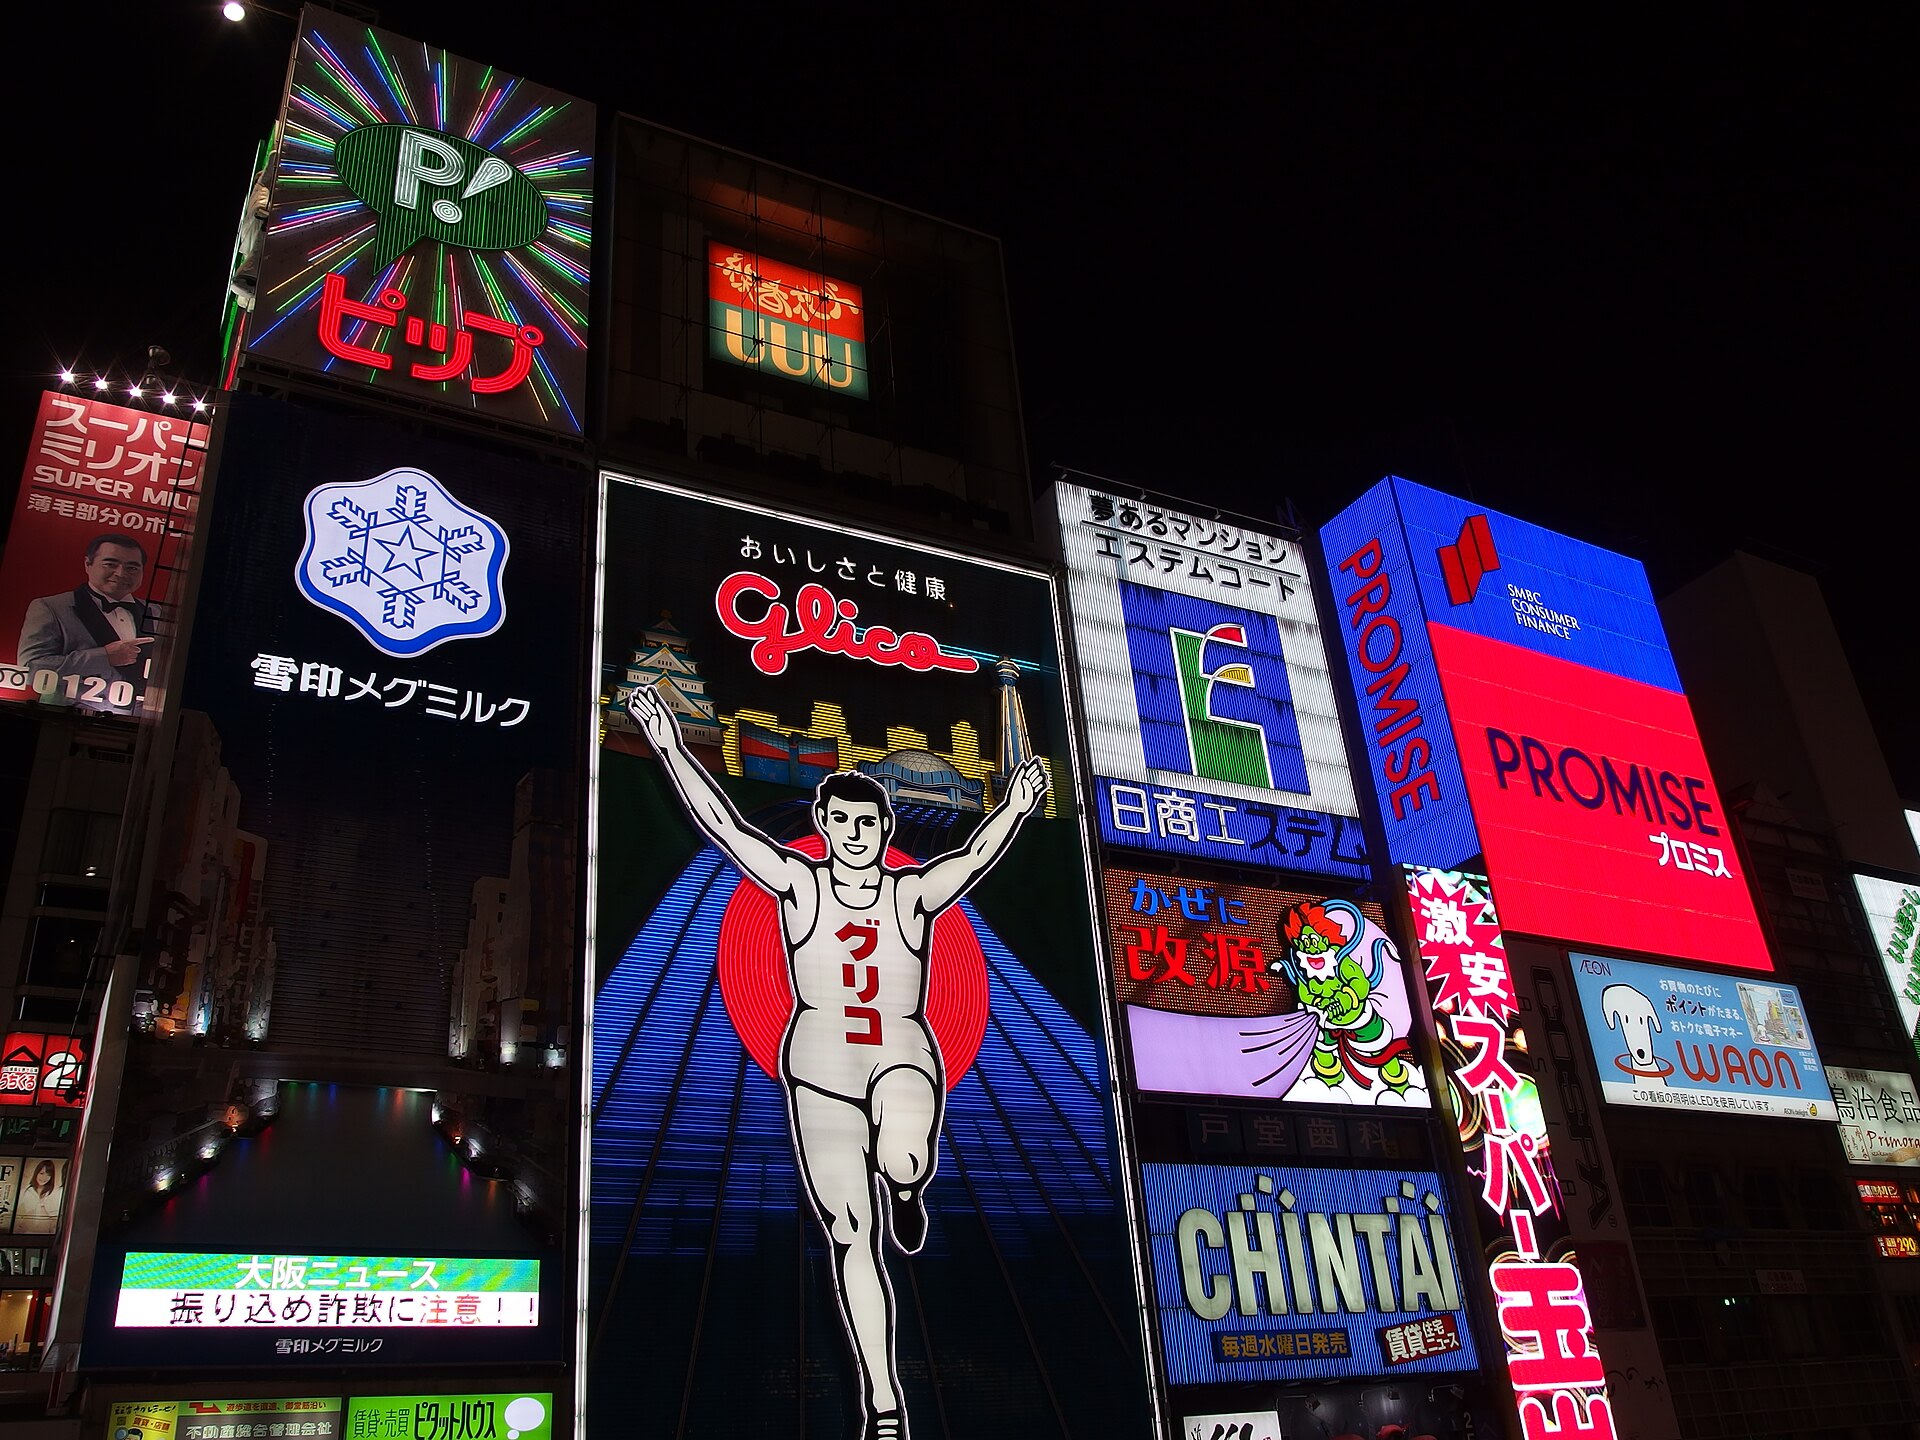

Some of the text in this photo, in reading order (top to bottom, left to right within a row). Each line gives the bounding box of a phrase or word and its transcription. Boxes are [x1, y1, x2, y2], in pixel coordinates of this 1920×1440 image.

[318, 272, 545, 393] ピップ
[726, 308, 853, 388] UUU
[45, 399, 206, 450] スーパー
[33, 464, 135, 499] SUPER
[1088, 495, 1287, 564] 夢あるマンション
[740, 535, 946, 601] おいしさと健康
[1095, 533, 1296, 602] エステムコート
[1507, 583, 1543, 605] SMBC
[1511, 598, 1581, 630] CONSUMER
[715, 570, 980, 676] Glico
[1515, 611, 1572, 640] FINANCE
[250, 652, 531, 727] 雪印メグミルク
[1340, 538, 1442, 821] PROMISE
[1485, 726, 1720, 837] PROMISE
[1110, 784, 1372, 864] 日商エステム
[1648, 831, 1733, 879] プロミス
[1129, 878, 1249, 926] かぜに
[834, 918, 884, 1047] グリコ
[1120, 925, 1271, 993] 改源
[1658, 979, 1722, 999] お買物のたびに
[1670, 1020, 1744, 1039] おトクな電子マネー
[1674, 1040, 1802, 1090] WAON
[233, 1255, 441, 1290] 大阪ニュース
[1177, 1176, 1460, 1320] CHINTAI
[275, 1338, 384, 1355] 雪印メグミルク
[1221, 1331, 1348, 1359] 毎週水曜日発売
[414, 1400, 497, 1440] ピタットハウス
